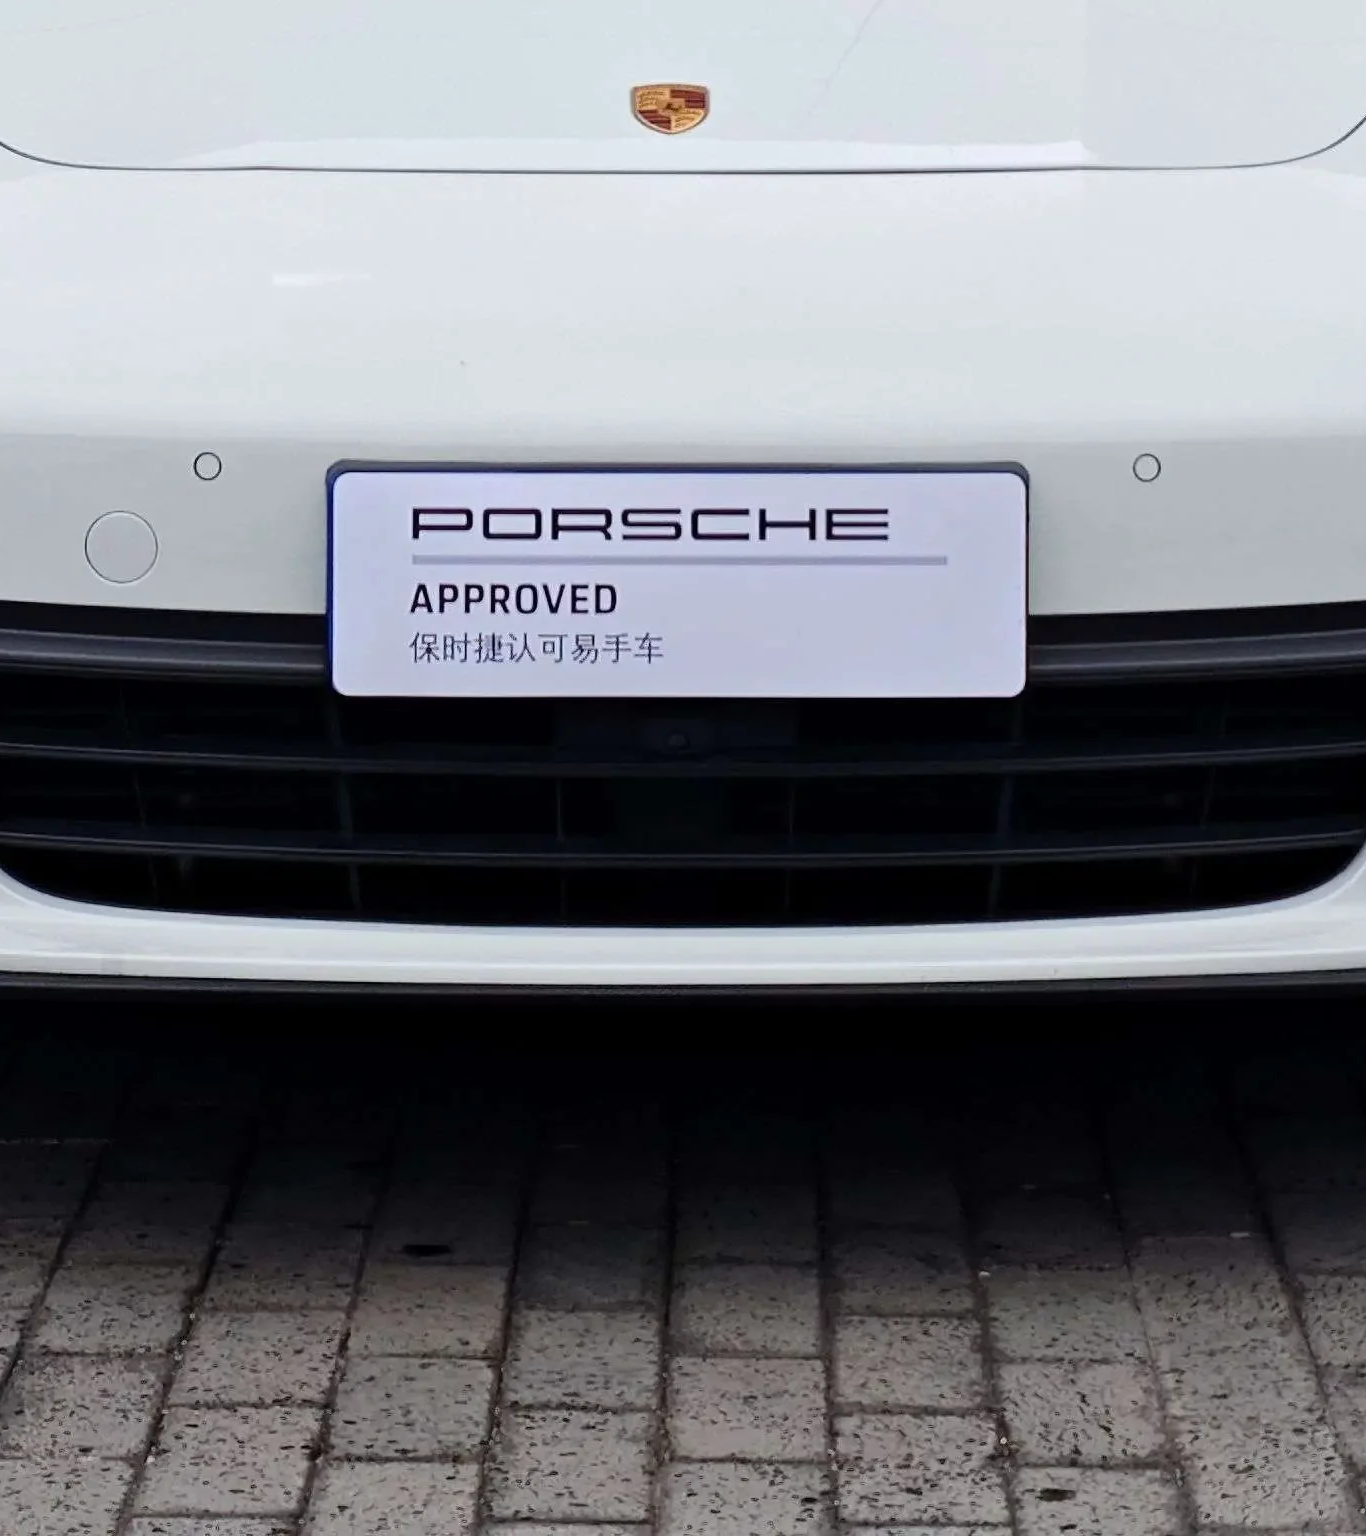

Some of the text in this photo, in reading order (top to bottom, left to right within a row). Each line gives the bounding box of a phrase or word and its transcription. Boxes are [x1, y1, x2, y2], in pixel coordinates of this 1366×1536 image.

[411, 507, 890, 541] PORSCHE
[409, 582, 618, 615] APPROVED
[408, 630, 665, 664] 保时捷认可易手车
